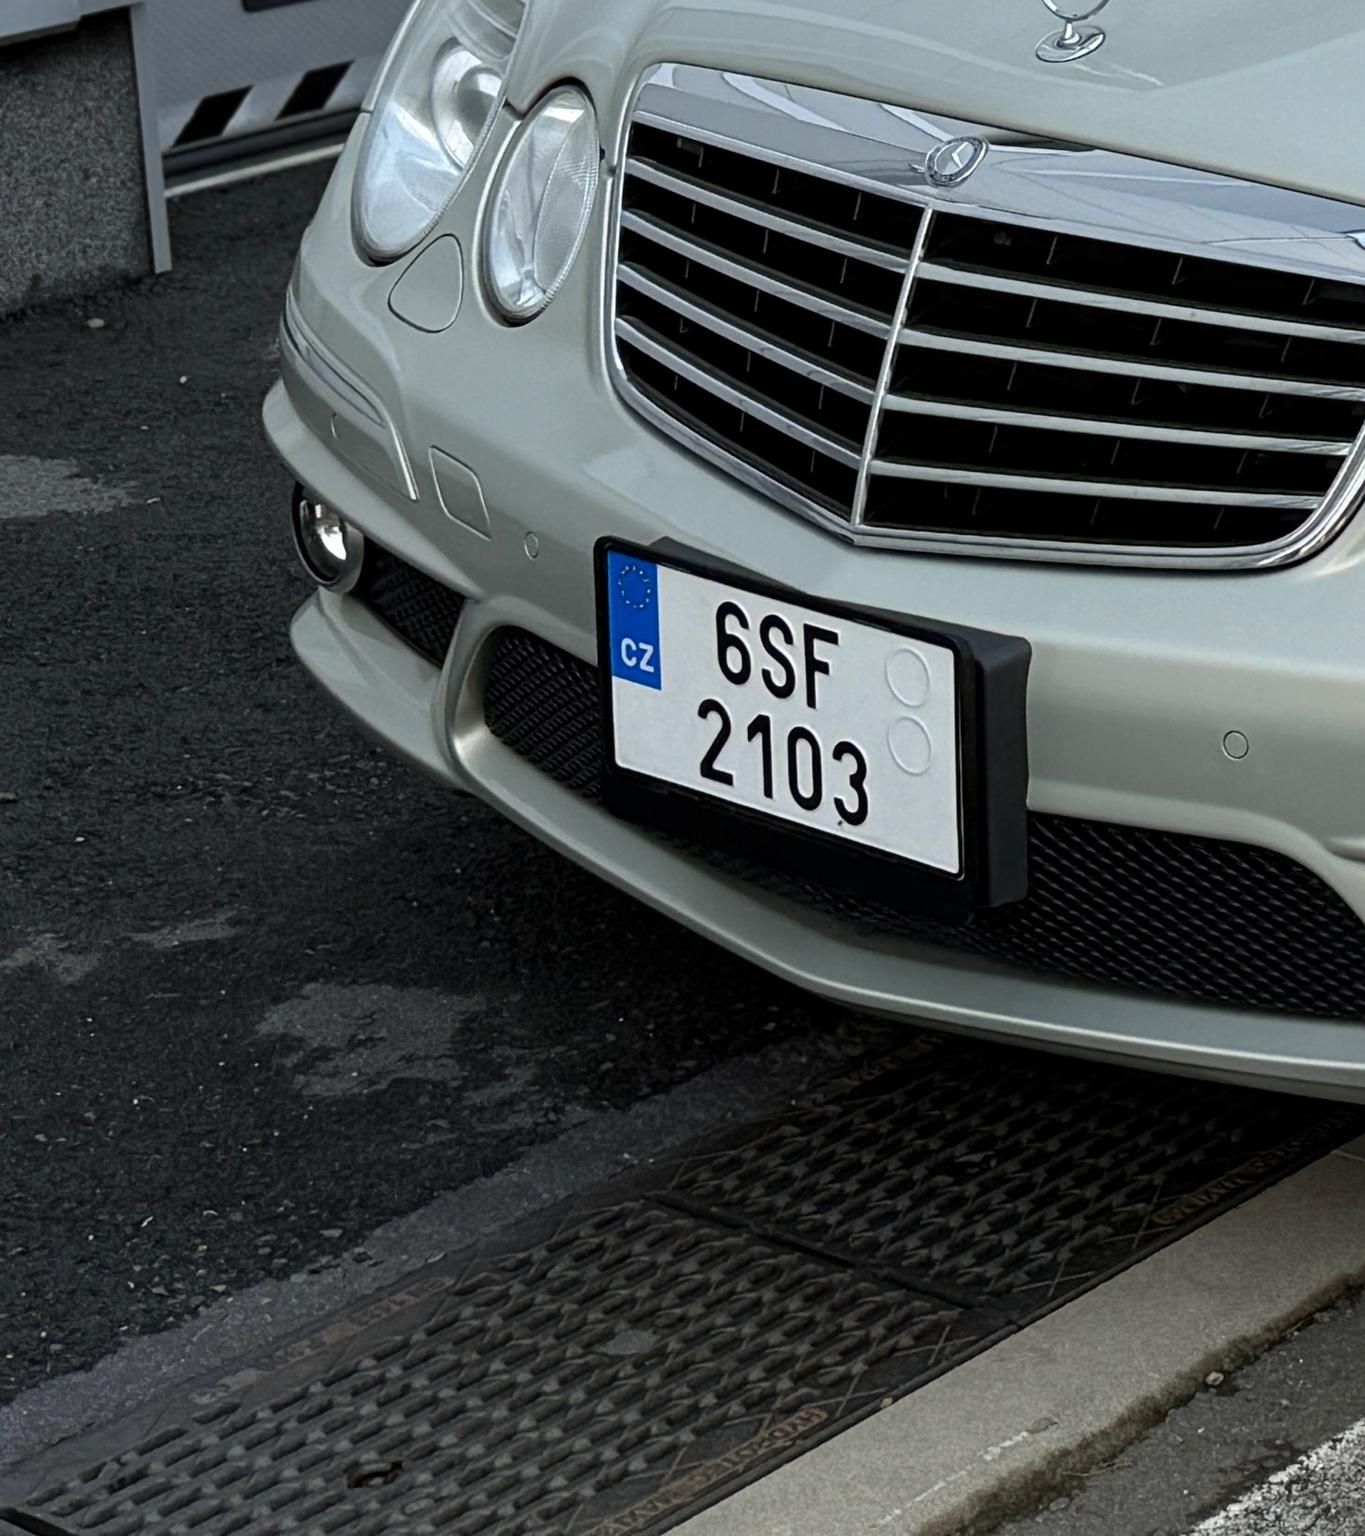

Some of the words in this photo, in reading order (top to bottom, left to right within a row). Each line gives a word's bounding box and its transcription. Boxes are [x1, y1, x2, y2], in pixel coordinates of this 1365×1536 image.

[620, 637, 656, 674] CZ
[715, 600, 840, 710] 6SF
[697, 698, 869, 826] 2103
